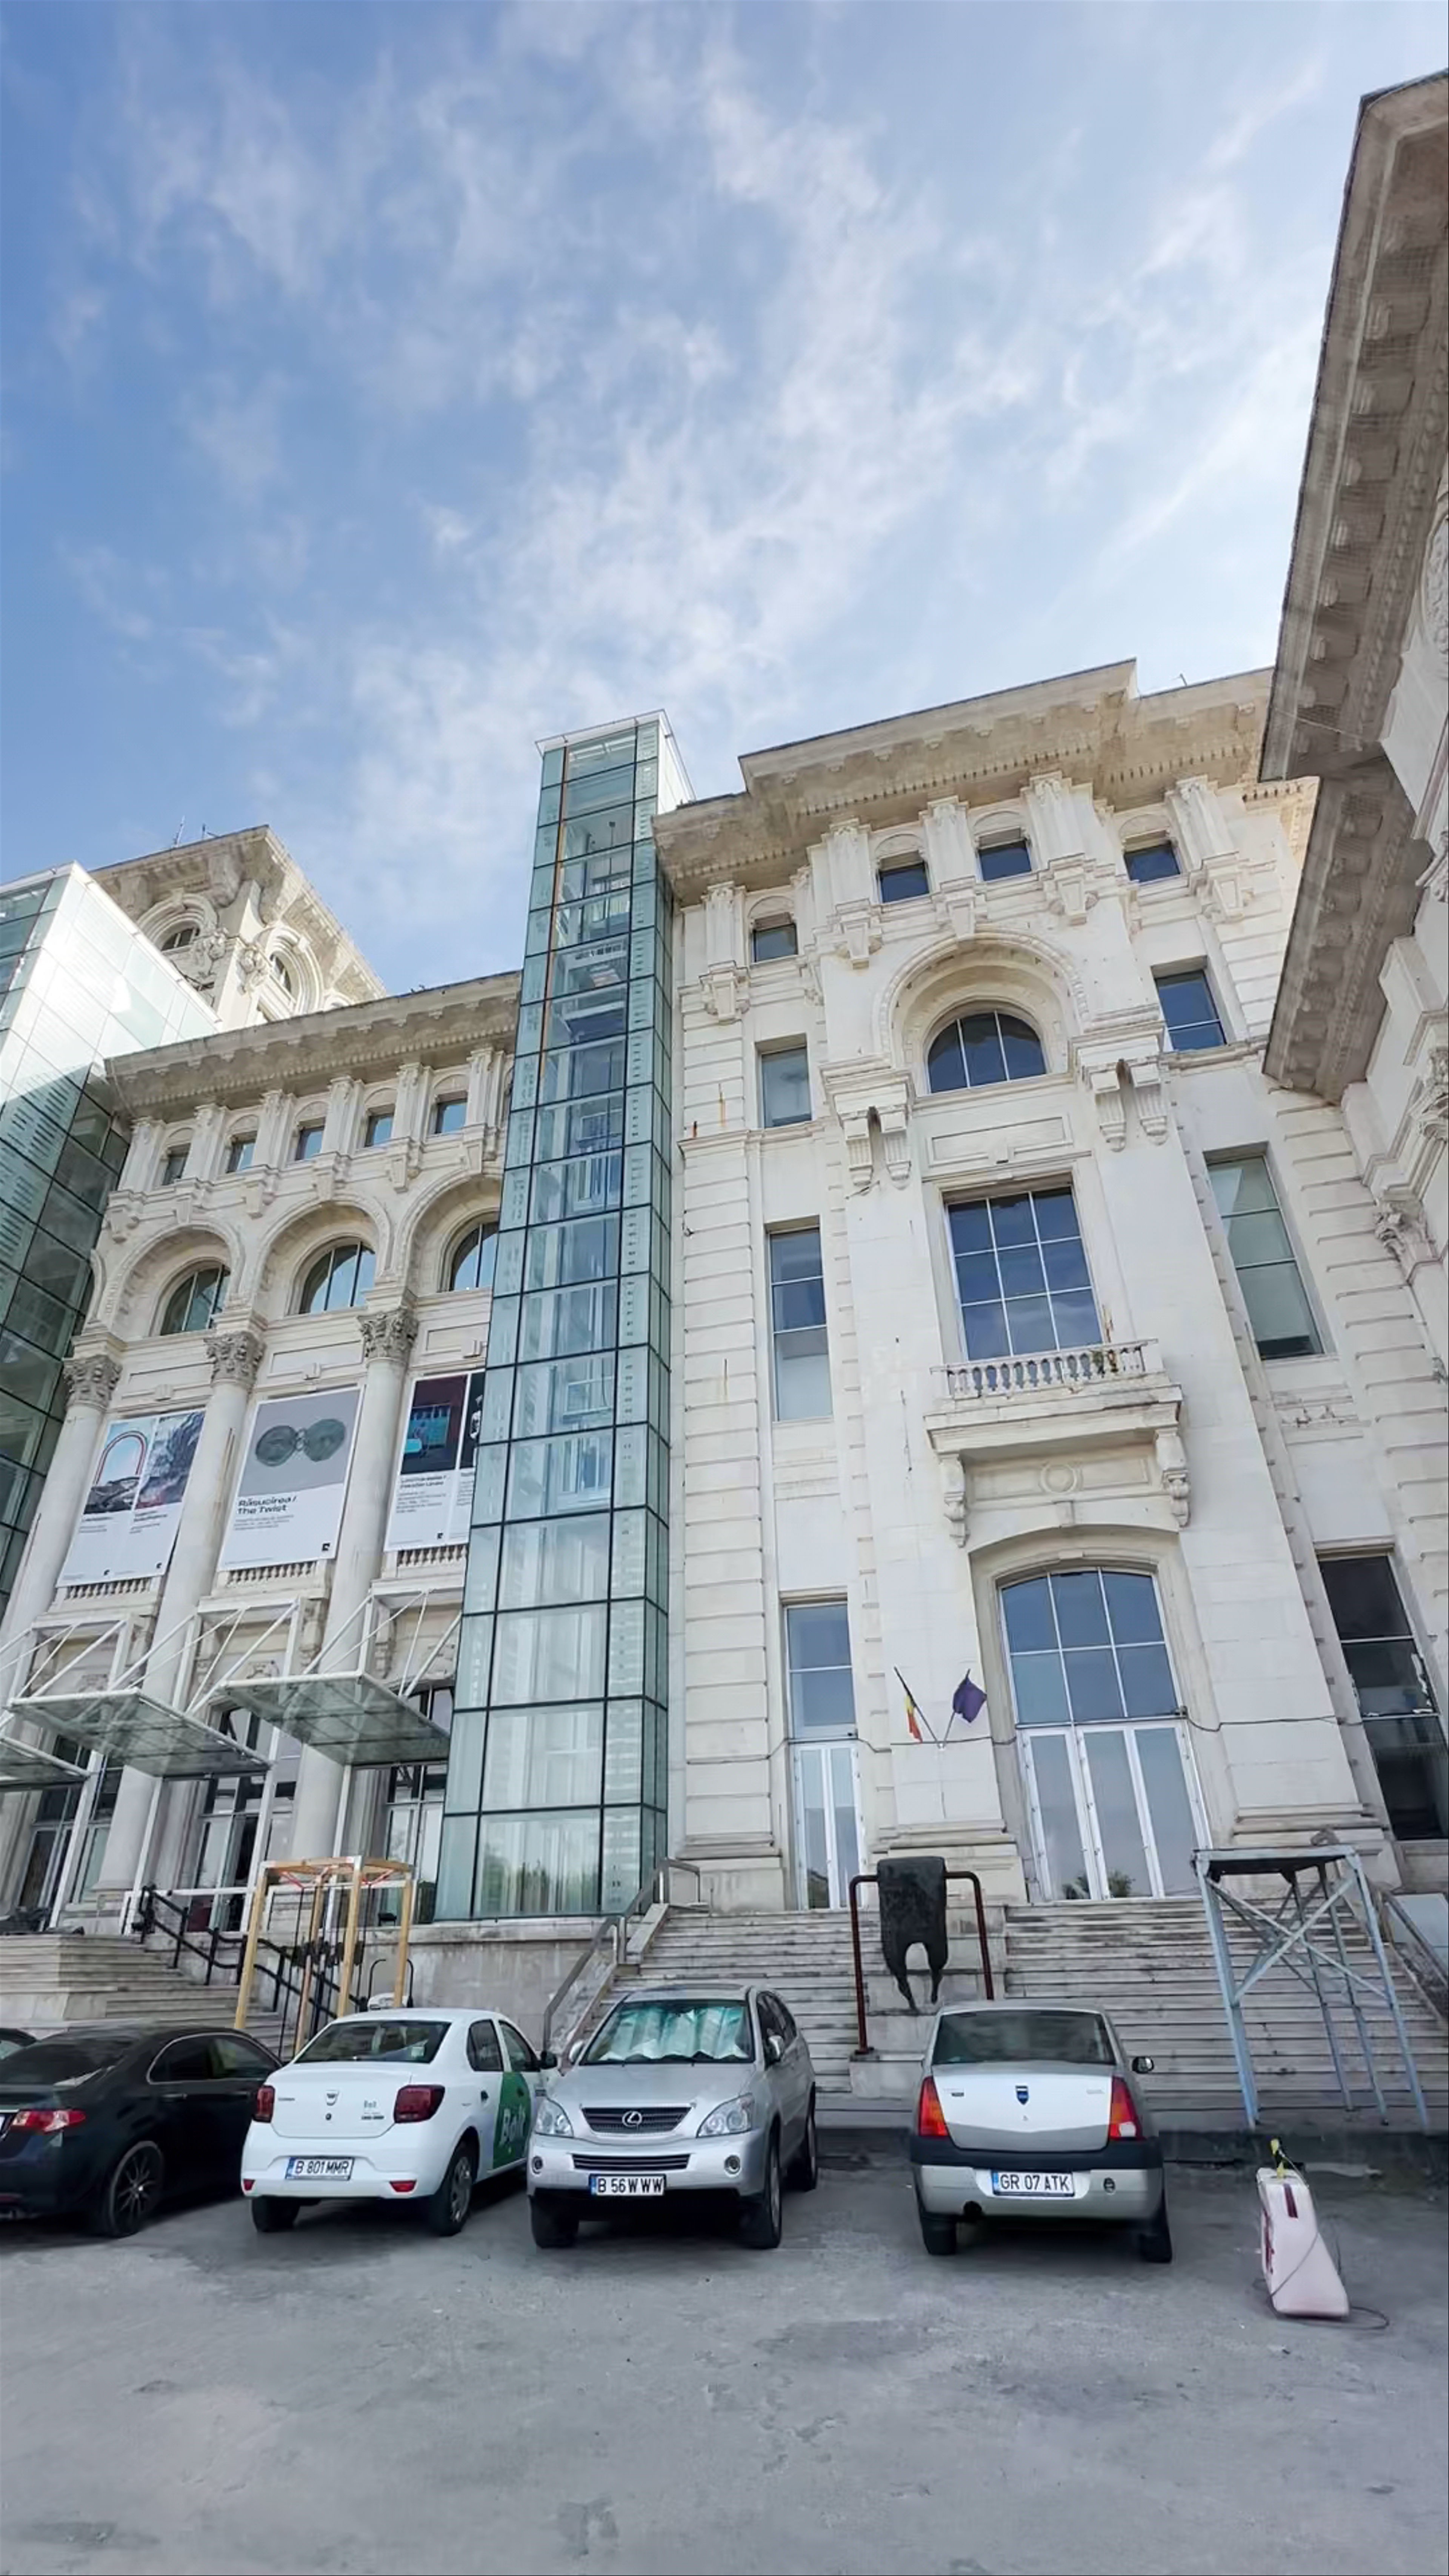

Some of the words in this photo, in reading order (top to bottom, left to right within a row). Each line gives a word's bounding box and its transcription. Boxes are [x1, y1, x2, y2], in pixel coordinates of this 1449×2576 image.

[260, 1504, 287, 1513] Twist
[499, 2105, 526, 2145] Bolt
[1000, 2174, 1020, 2190] GR
[1024, 2175, 1040, 2190] 07
[1044, 2175, 1070, 2191] ATK
